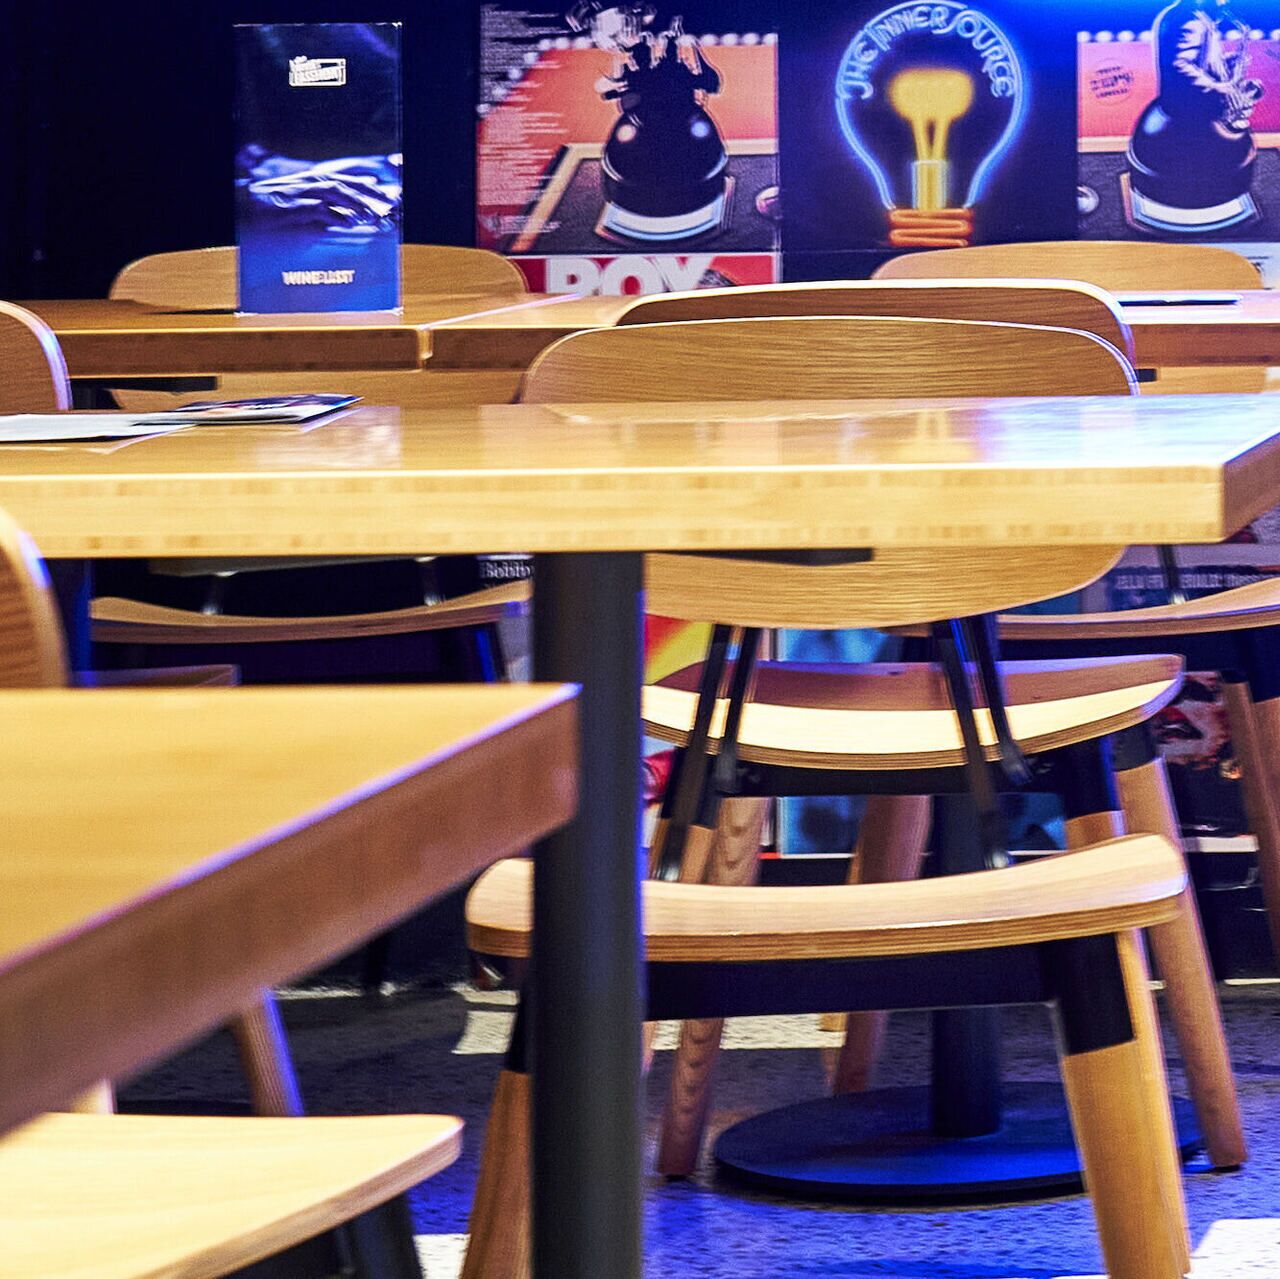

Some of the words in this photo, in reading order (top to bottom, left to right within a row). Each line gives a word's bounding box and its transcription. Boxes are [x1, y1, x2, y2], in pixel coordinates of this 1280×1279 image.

[864, 5, 951, 53] INNER
[932, 8, 1017, 98] SOURCE
[281, 270, 325, 286] WINE
[325, 270, 356, 285] LIST
